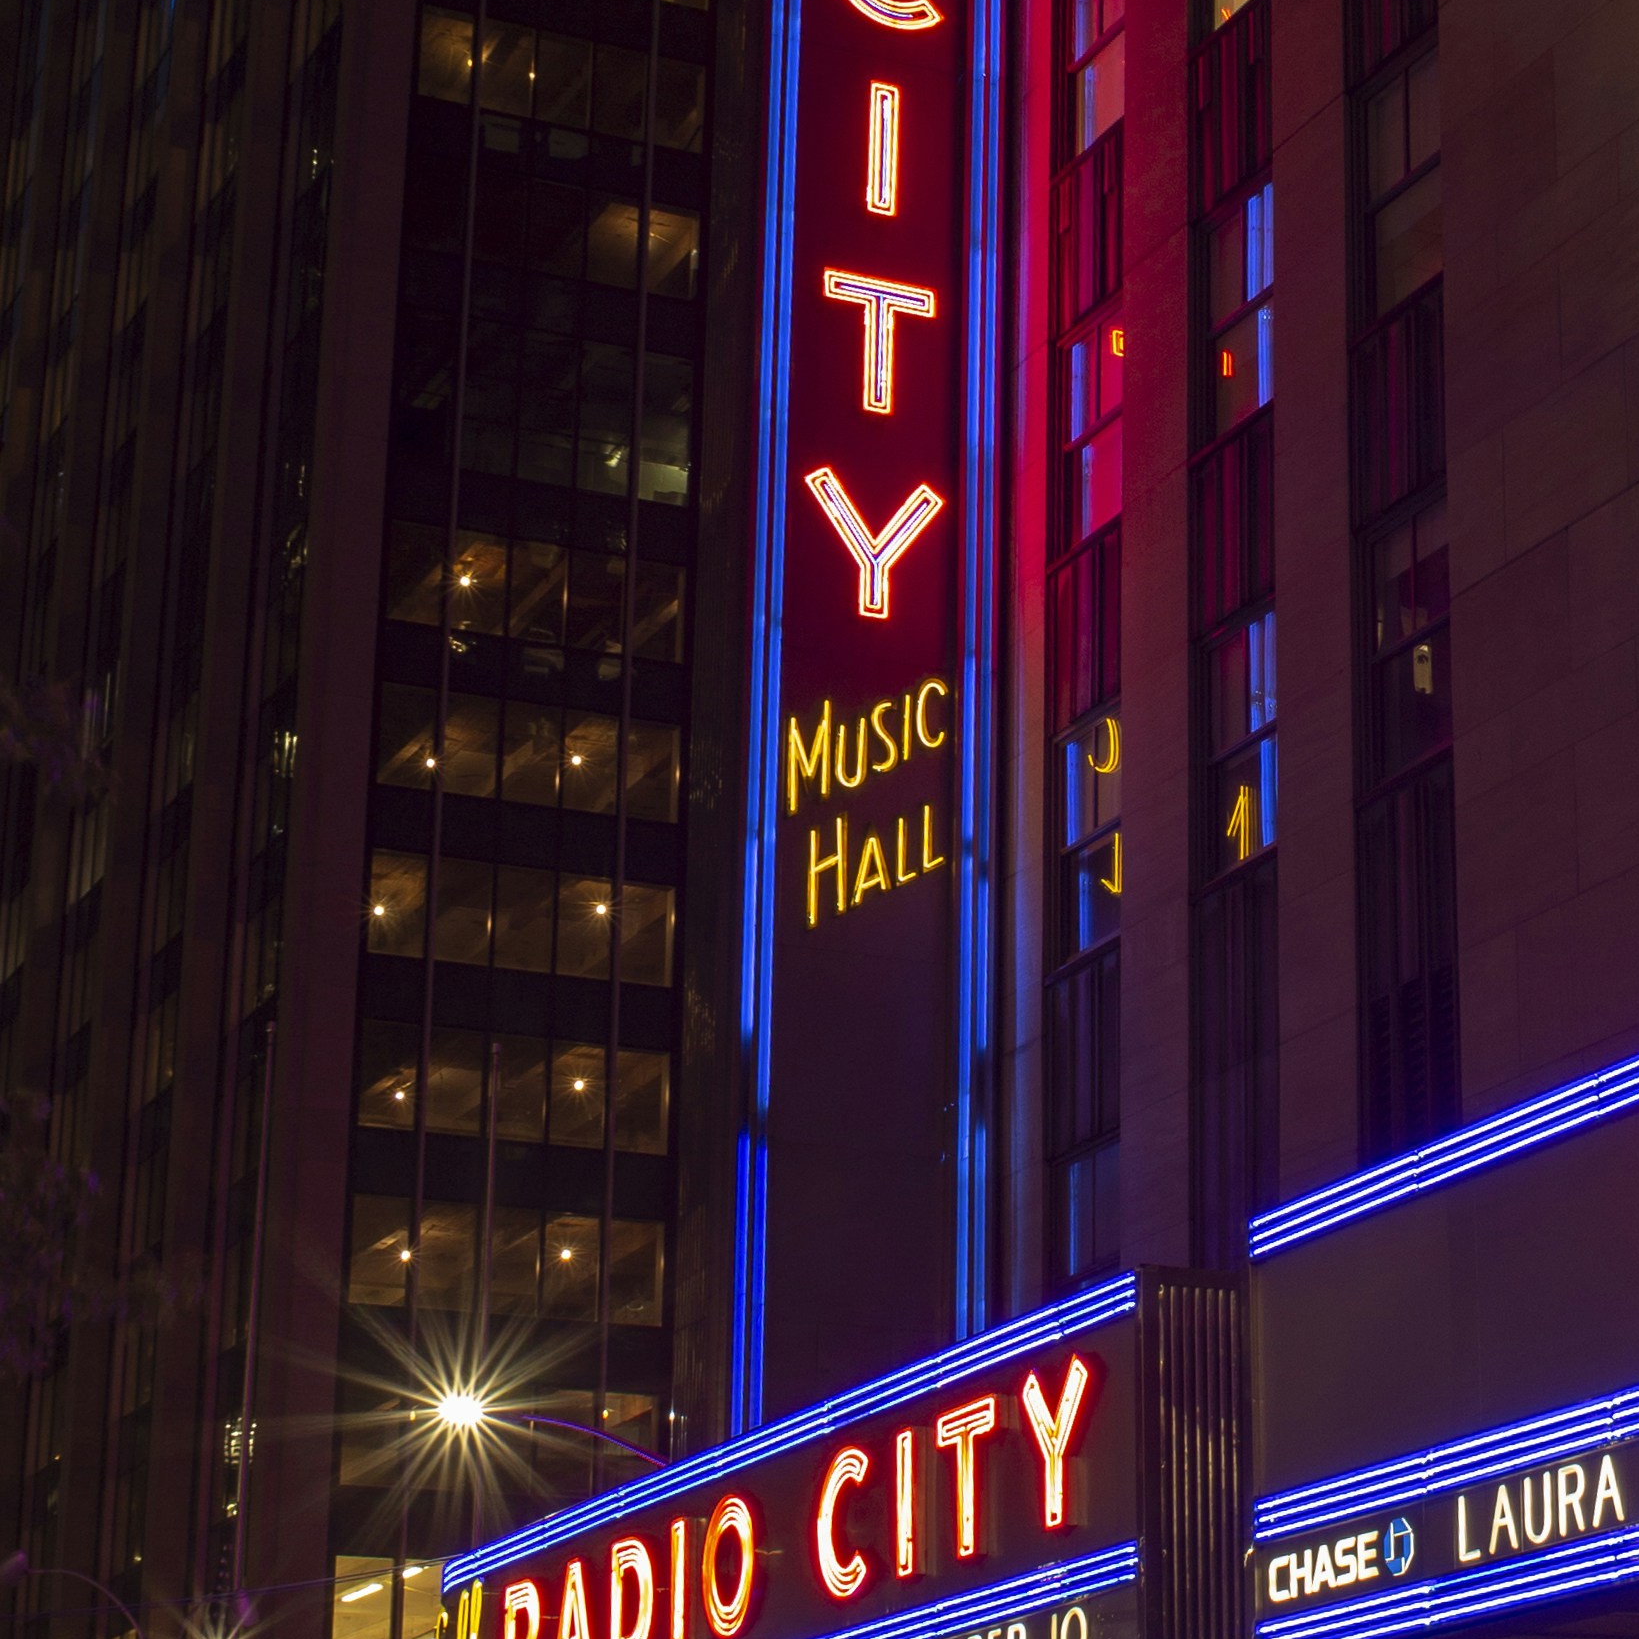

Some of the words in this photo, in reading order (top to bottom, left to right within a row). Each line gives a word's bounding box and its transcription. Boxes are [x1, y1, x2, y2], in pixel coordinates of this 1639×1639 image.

[807, 804, 946, 928] HALL
[816, 1353, 1089, 1599] CITY
[1457, 1455, 1625, 1562] LAURA
[1269, 1530, 1379, 1602] CHASE
